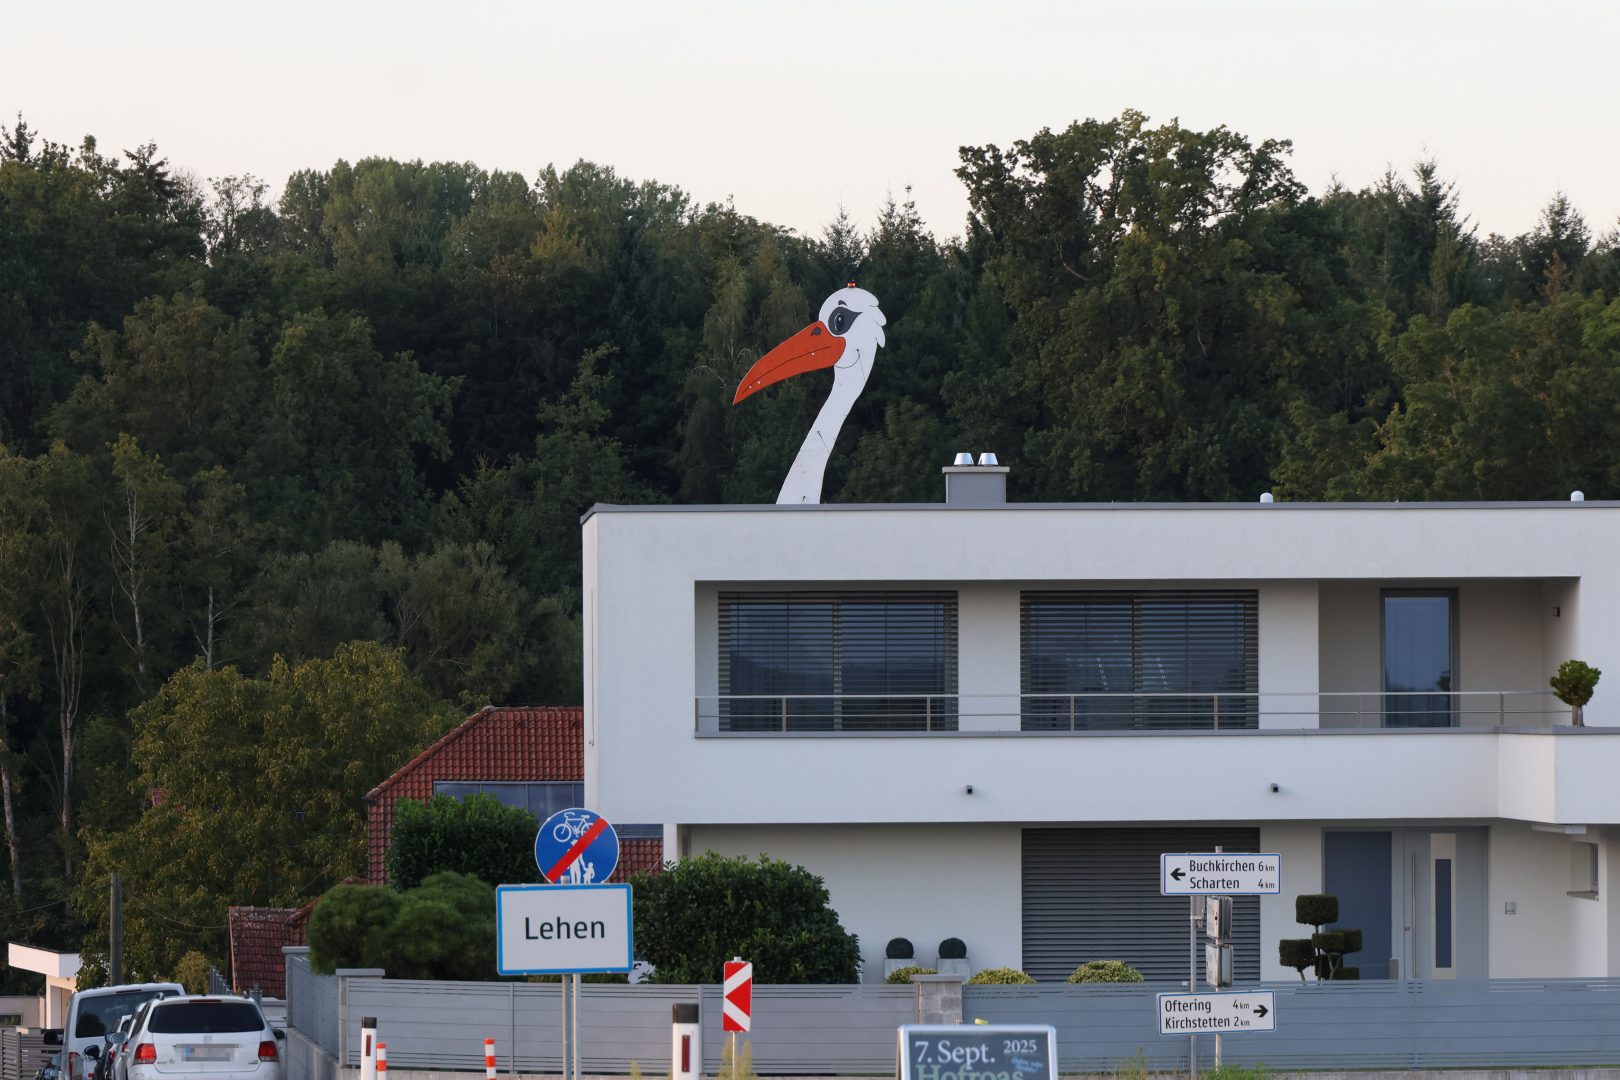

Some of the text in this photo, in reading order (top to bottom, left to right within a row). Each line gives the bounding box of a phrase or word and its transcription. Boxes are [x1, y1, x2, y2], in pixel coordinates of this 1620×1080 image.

[1189, 859, 1275, 872] Buchkirchen 6 km
[1189, 876, 1275, 889] Scharten 4 km
[525, 916, 605, 940] Lehen
[1165, 999, 1212, 1013] Oftering
[1232, 999, 1239, 1010] 4
[1165, 1016, 1230, 1030] Kirchstetten
[1234, 1016, 1240, 1027] 2
[915, 1040, 932, 1063] 7.
[937, 1040, 996, 1070] Sept.
[1003, 1039, 1037, 1054] 2025
